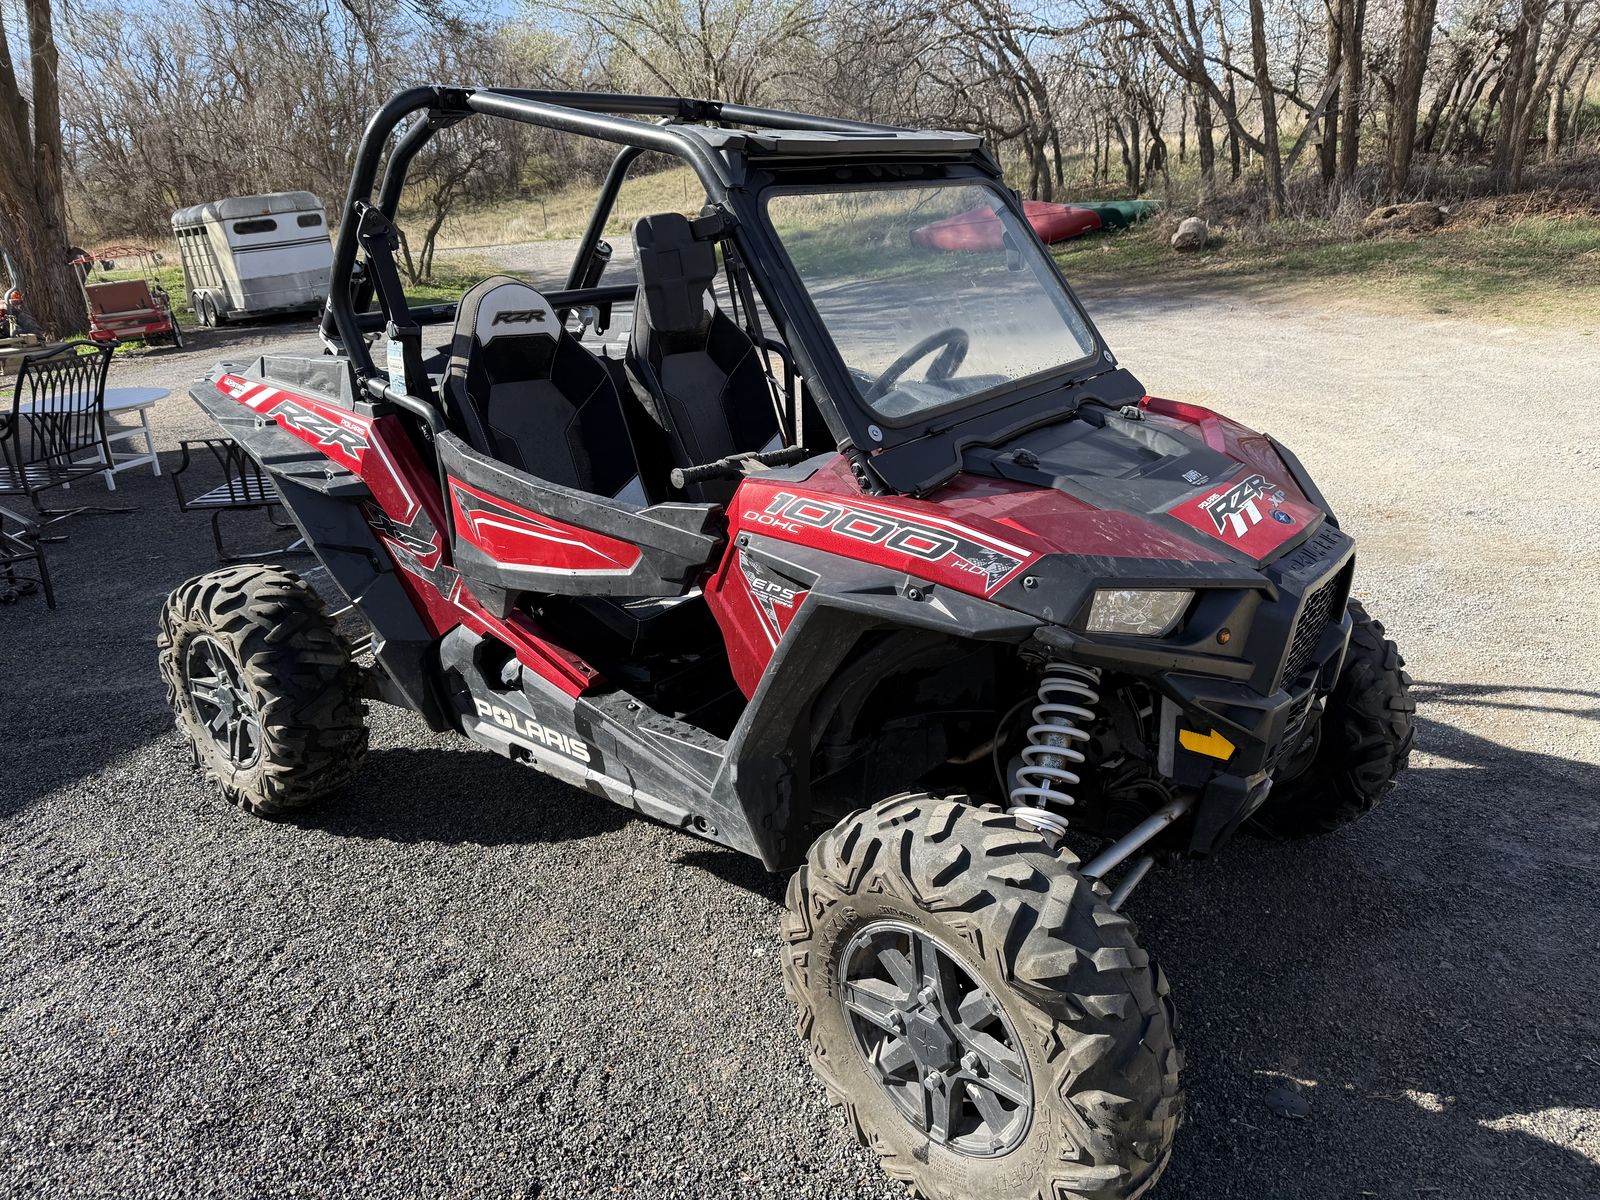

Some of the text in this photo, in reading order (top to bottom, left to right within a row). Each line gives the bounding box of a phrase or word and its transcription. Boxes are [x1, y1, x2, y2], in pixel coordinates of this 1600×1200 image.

[491, 309, 547, 327] RZR
[267, 399, 371, 461] RZR
[1198, 493, 1221, 510] POLARIS
[1206, 473, 1277, 536] RZR
[1268, 491, 1286, 507] XP
[742, 510, 804, 535] DOHC
[763, 491, 959, 563] 1000
[752, 577, 797, 600] EPS
[473, 697, 591, 763] POLARIS
